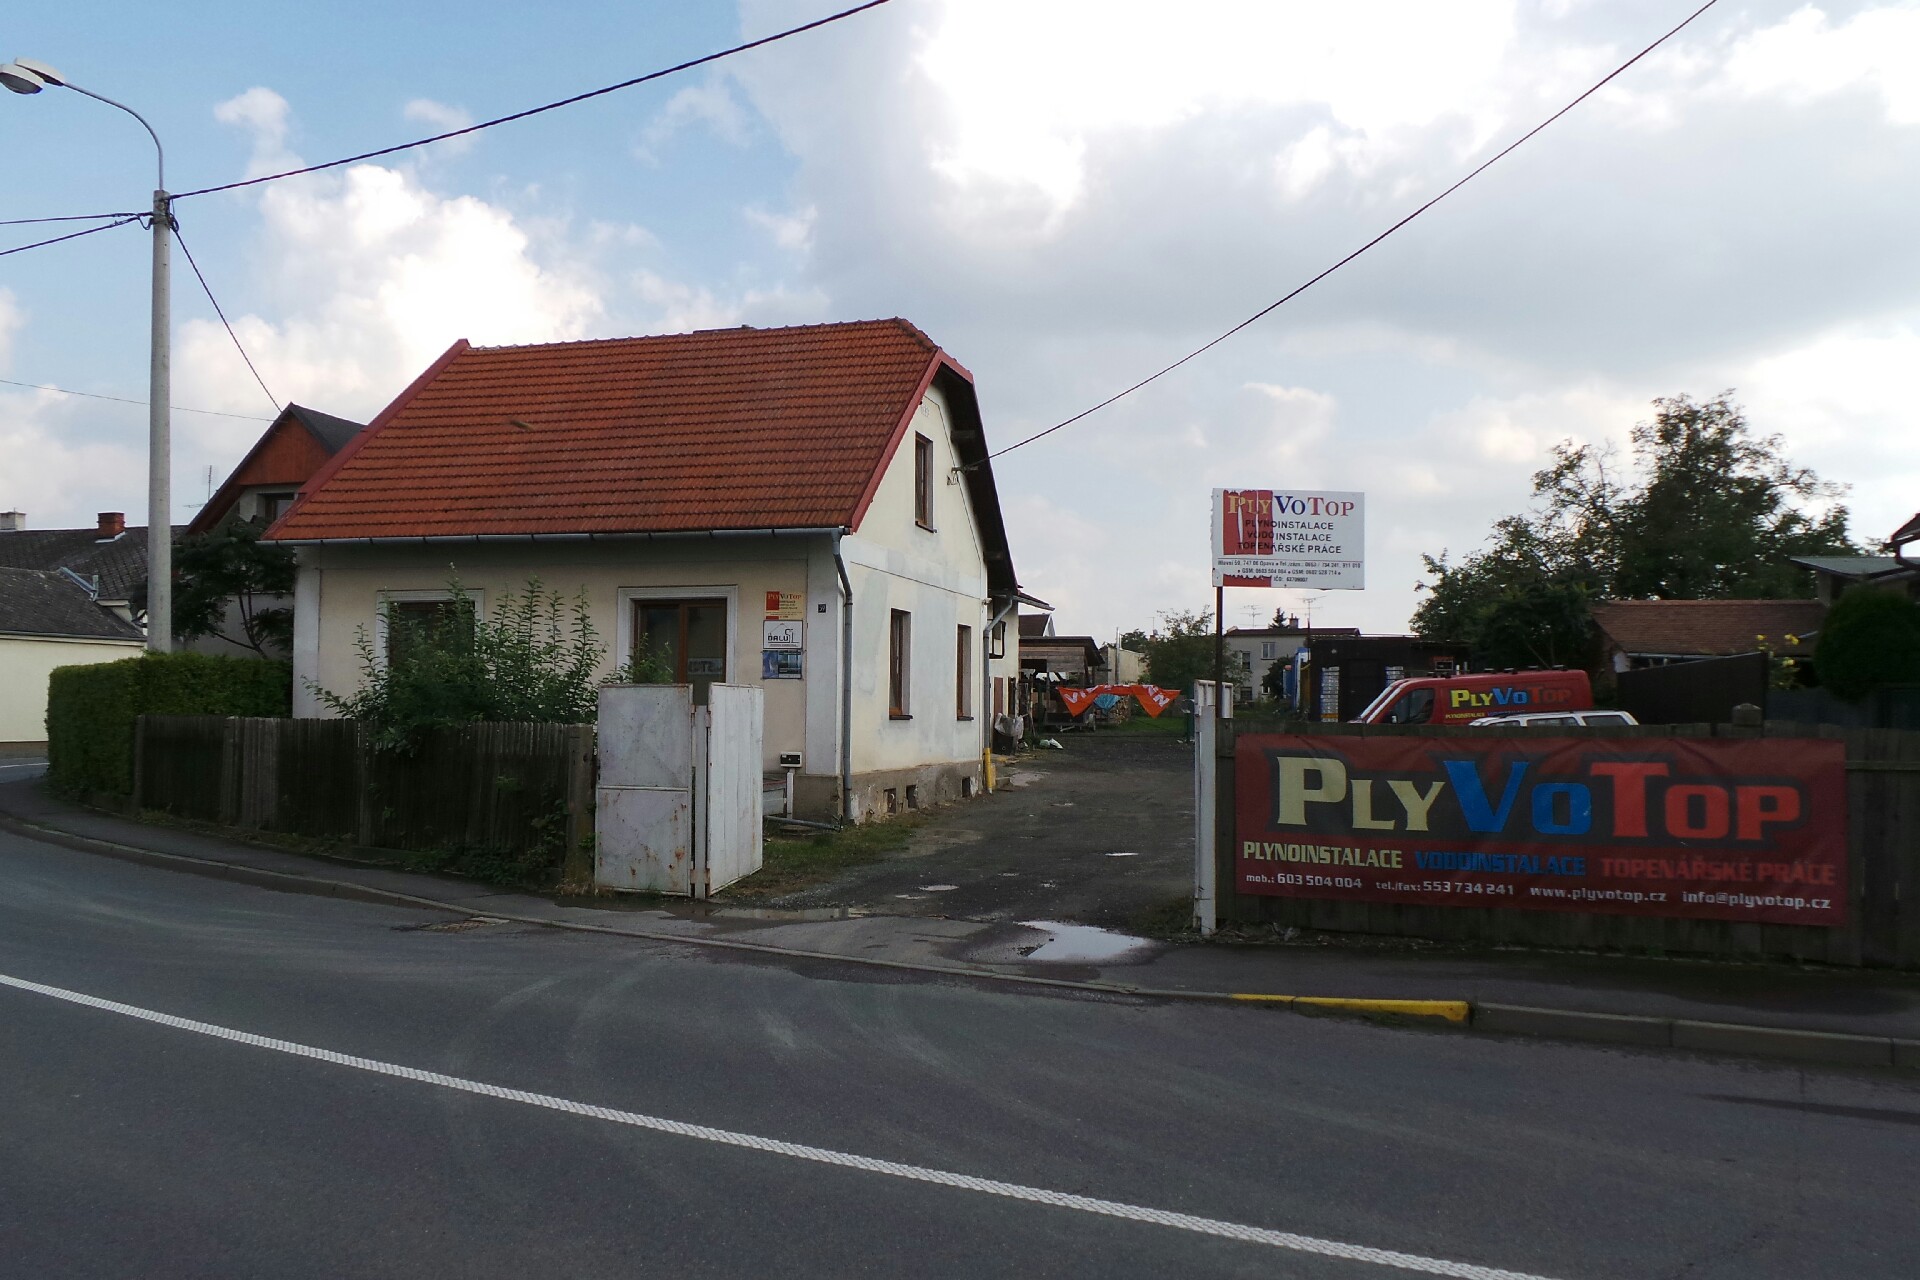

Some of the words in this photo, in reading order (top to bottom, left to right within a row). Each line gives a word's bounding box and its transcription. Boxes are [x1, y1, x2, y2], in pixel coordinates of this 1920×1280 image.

[1245, 519, 1334, 531] PLYNOINSTALACE
[1247, 531, 1332, 542] VODOINSTALACE
[1236, 542, 1305, 554] TOPENÁŘSKÉ
[1308, 543, 1342, 554] PRÁCE
[1243, 840, 1403, 869] PLYNOINSTALACE
[1414, 850, 1586, 876] VODOINSTALACE
[1600, 854, 1751, 882] TOPENÁŘSKÉ
[1757, 859, 1836, 886] PRÁCE
[1245, 873, 1275, 885] mob.:
[1277, 873, 1303, 886] 603
[1305, 874, 1333, 888] 504
[1334, 876, 1363, 889] 004
[1375, 880, 1421, 892] tel./fax:
[1422, 880, 1451, 893] 553
[1454, 882, 1483, 895] 734
[1486, 883, 1514, 896] 241
[1529, 886, 1668, 904] www.plyvotop.cz
[1682, 890, 1831, 910] info@plyvotop.cz
